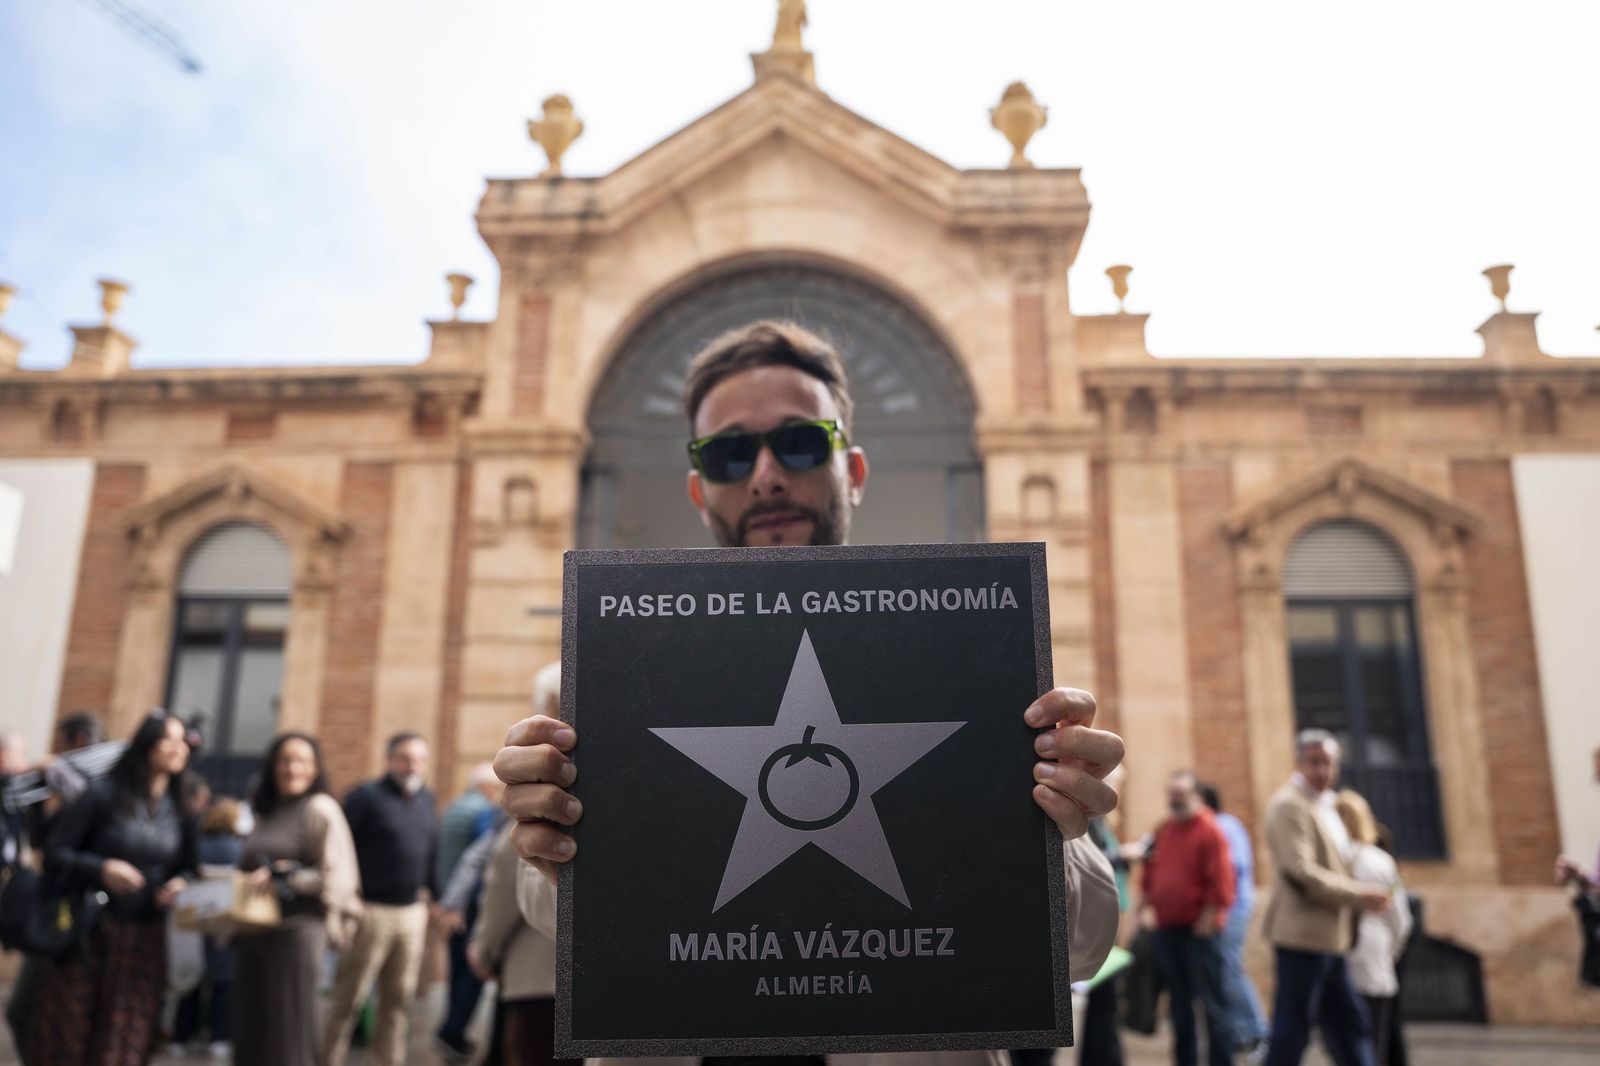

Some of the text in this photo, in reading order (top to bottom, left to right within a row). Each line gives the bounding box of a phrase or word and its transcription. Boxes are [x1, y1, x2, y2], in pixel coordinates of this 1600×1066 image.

[599, 581, 1019, 618] PASEO DE LA GASTRONOMÍA
[669, 922, 956, 961] MARÍA VÁZQUEZ
[754, 971, 874, 996] ALMERÍA
